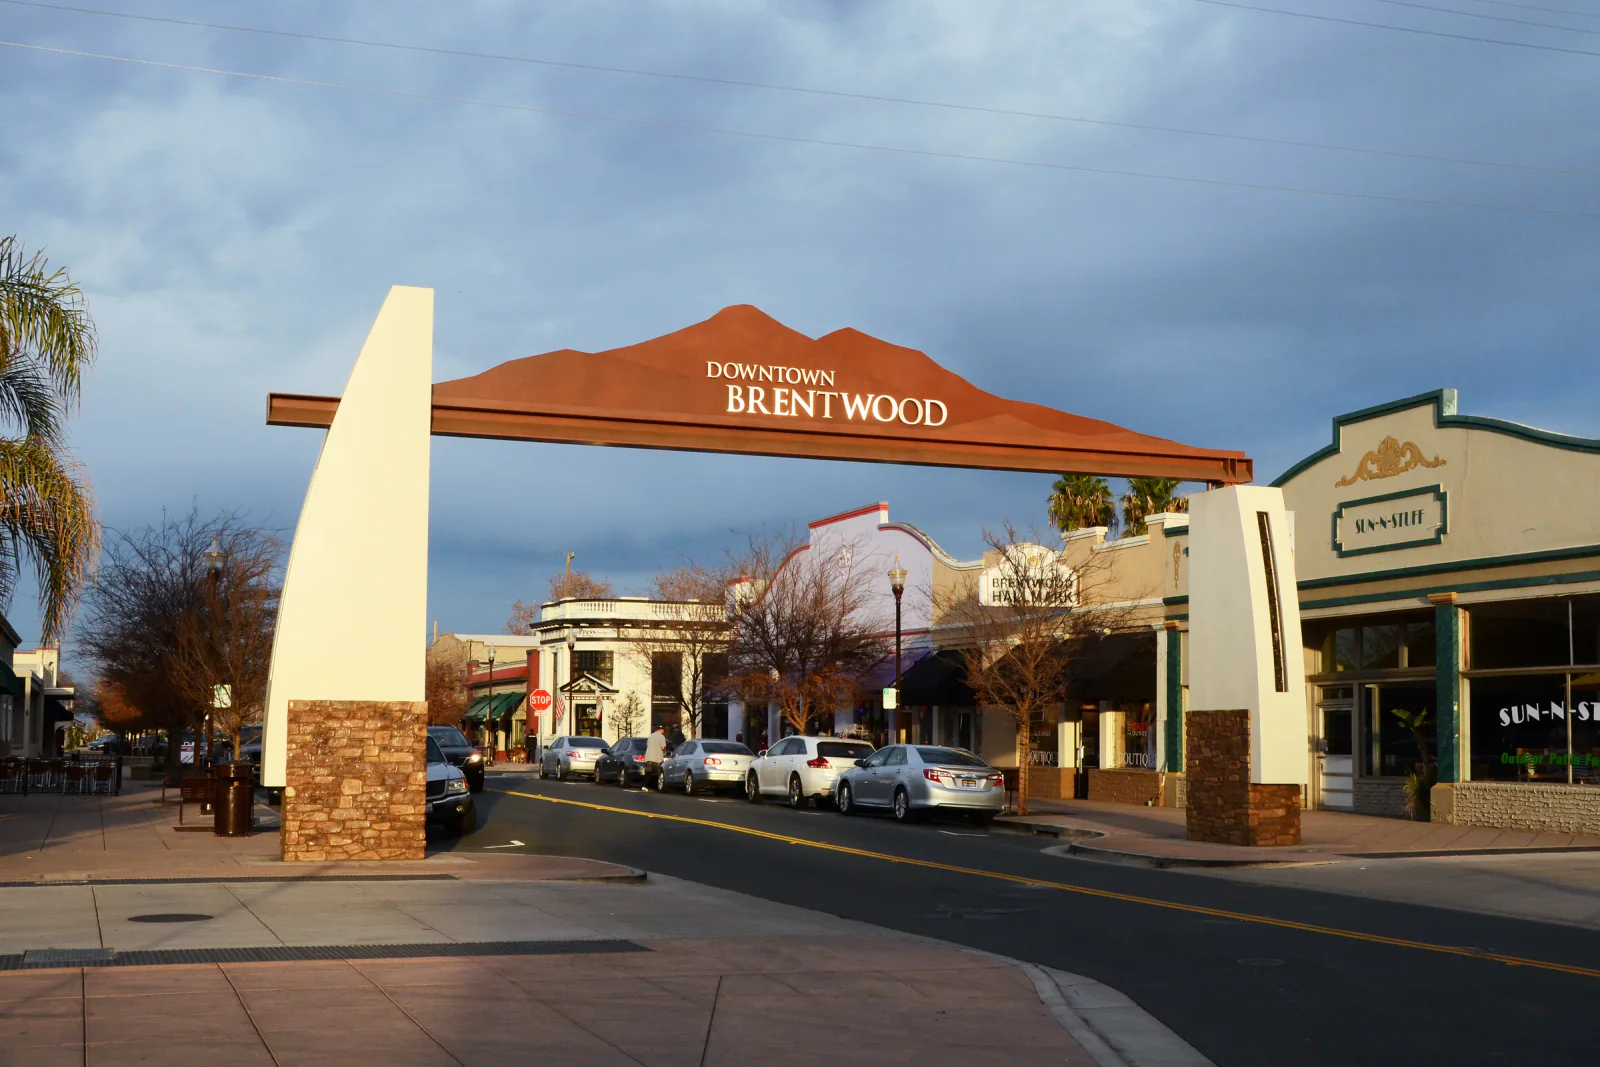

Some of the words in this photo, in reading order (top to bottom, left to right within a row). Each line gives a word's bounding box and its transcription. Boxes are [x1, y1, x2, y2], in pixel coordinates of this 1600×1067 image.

[706, 361, 836, 387] DOWNTOWN
[725, 384, 948, 427] BRENTWOOD
[1355, 508, 1425, 534] SUN-N-STUFF
[531, 695, 551, 705] STOP
